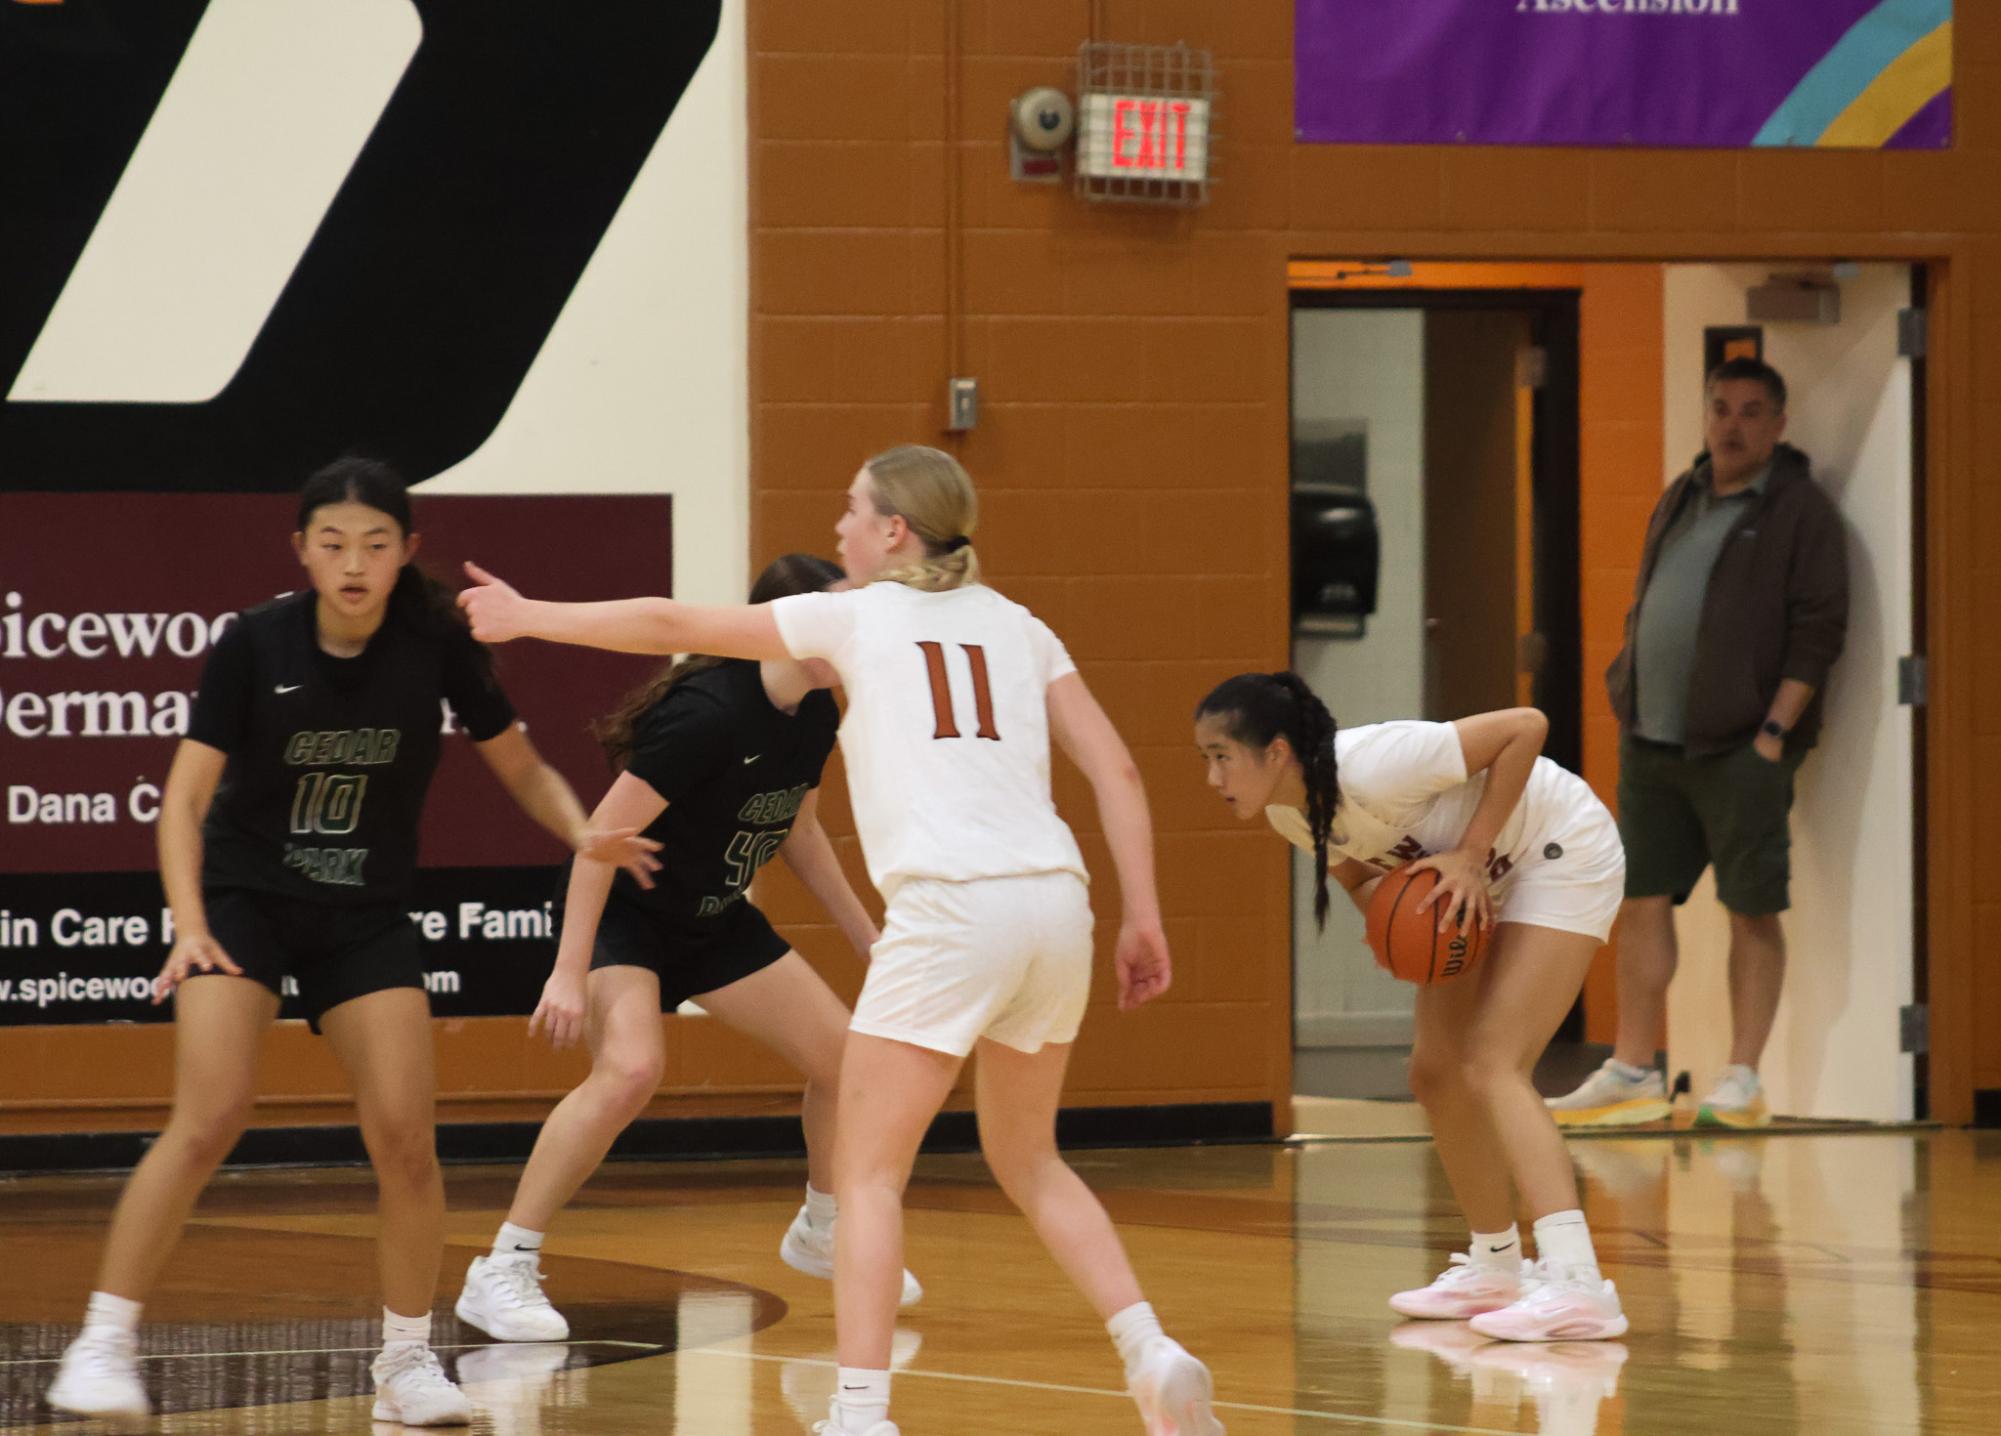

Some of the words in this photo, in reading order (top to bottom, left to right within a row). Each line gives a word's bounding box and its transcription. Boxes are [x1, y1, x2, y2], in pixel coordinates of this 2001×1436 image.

[1112, 100, 1191, 170] EXIT
[0, 591, 239, 659] icewo
[0, 682, 199, 738] erma
[913, 640, 1002, 741] 11
[284, 728, 400, 766] CEDAR
[8, 785, 117, 823] Dana
[290, 771, 369, 834] 10
[51, 908, 149, 946] Care
